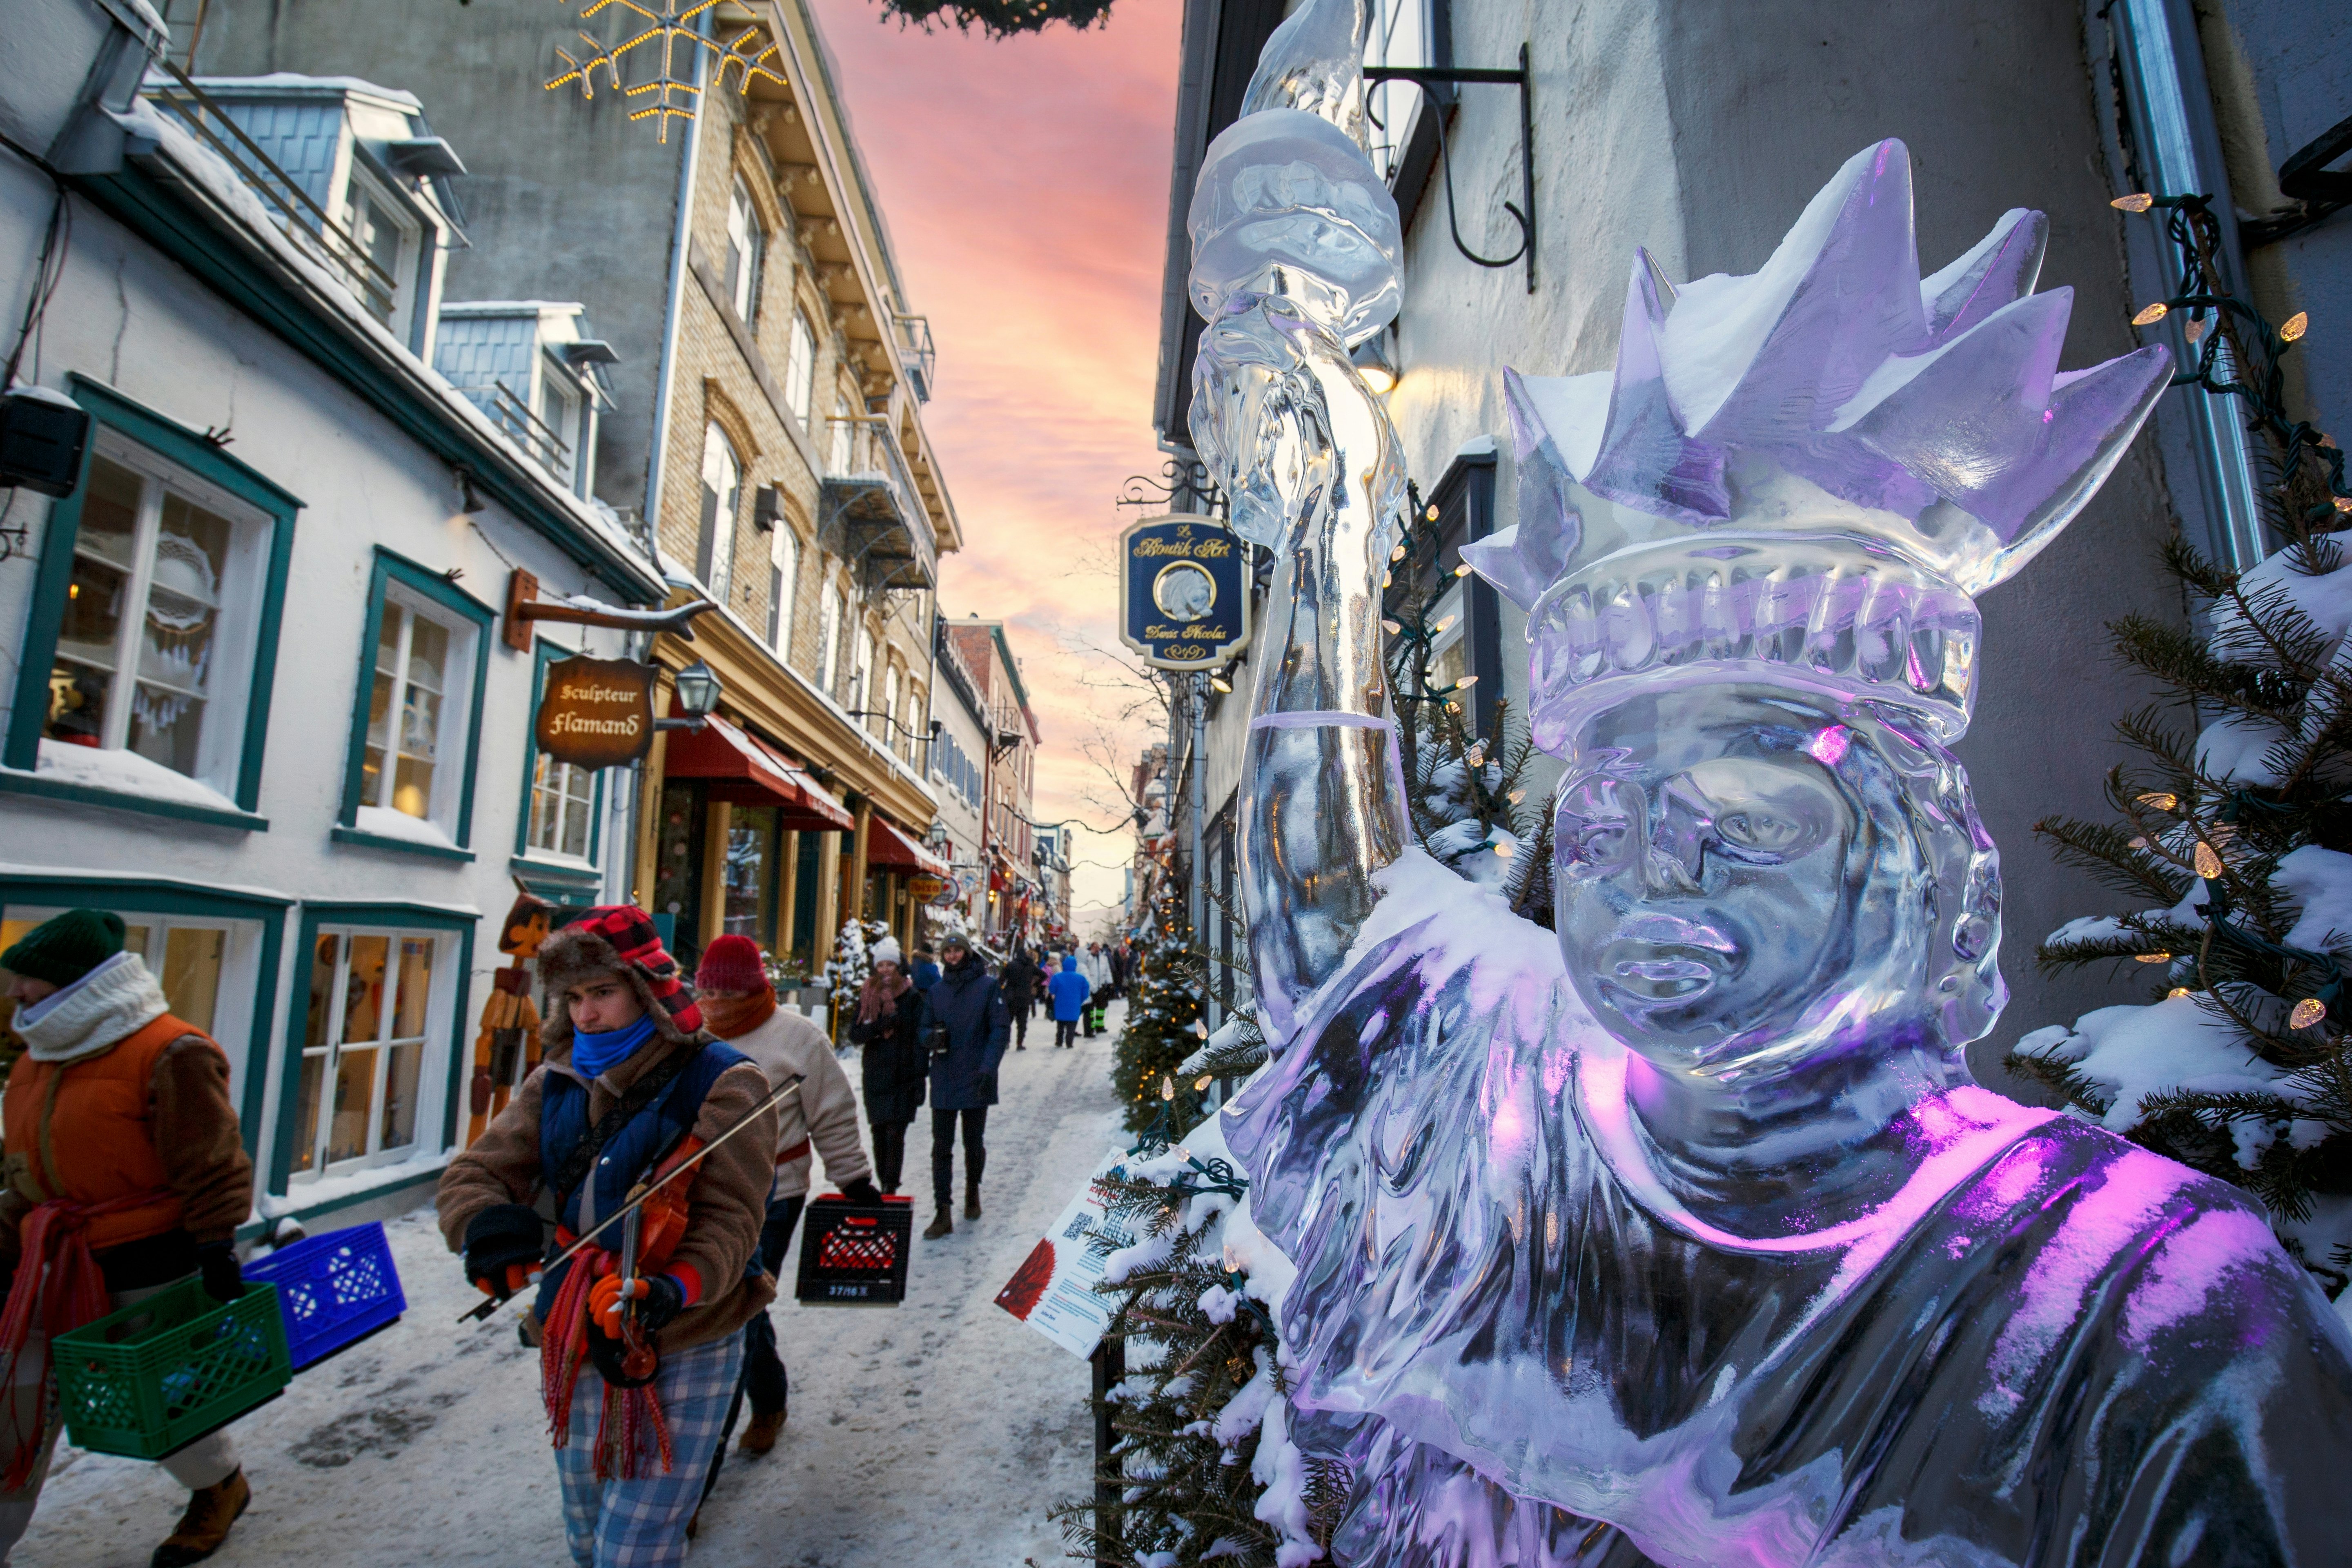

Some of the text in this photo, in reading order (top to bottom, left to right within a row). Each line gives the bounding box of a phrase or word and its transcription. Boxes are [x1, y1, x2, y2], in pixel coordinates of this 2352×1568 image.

[1133, 537, 1231, 558] Boutik Art
[1145, 624, 1227, 639] Denis Nicolas
[560, 684, 637, 704] Sculpteur
